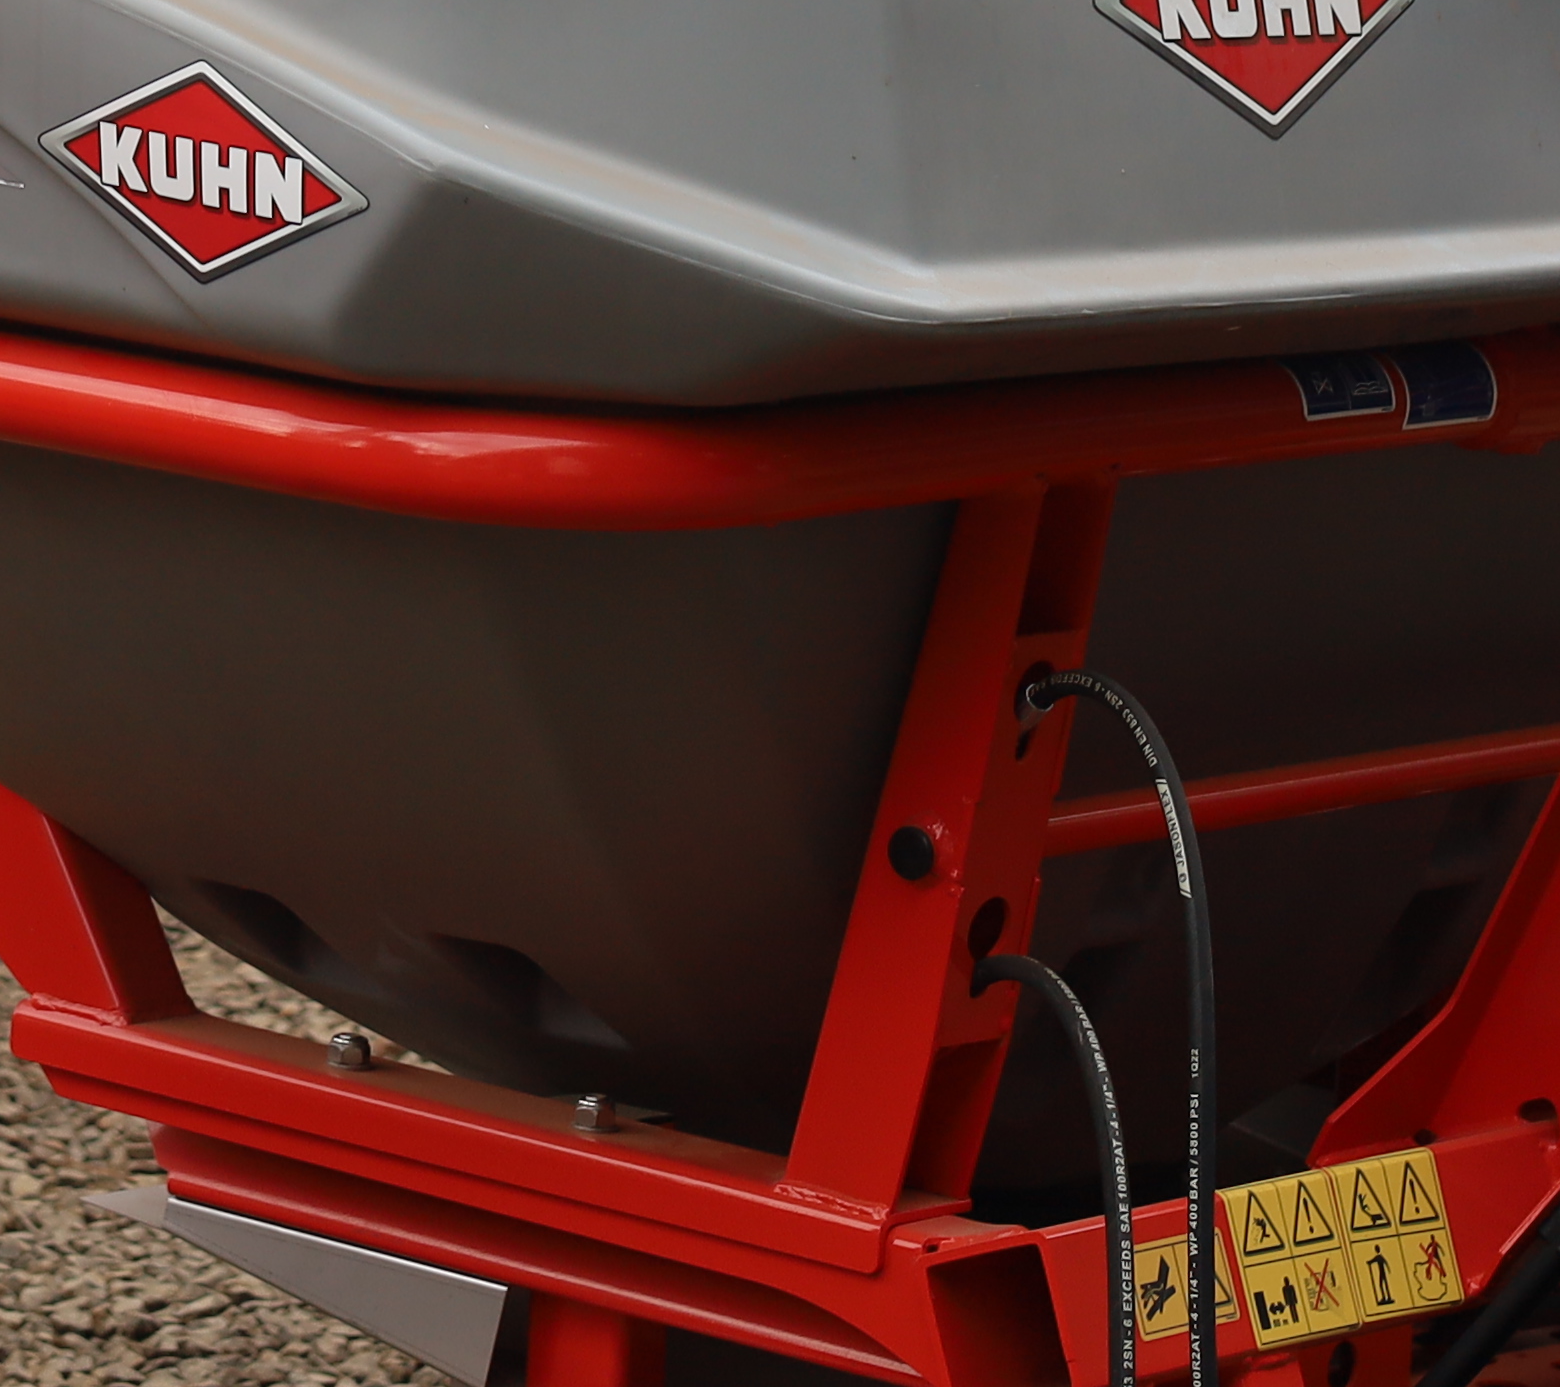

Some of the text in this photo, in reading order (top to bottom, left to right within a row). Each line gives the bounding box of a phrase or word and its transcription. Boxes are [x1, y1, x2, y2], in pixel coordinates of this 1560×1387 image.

[97, 121, 305, 225] KUHN
[1160, 789, 1185, 868] JASONFLEX
[1093, 1051, 1109, 1073] WP
[1190, 1093, 1200, 1118] PSI
[1112, 1138, 1129, 1198] 100R2AT
[1188, 1168, 1199, 1199] BAR
[1120, 1203, 1132, 1234] SAE
[1188, 1200, 1199, 1230] 400
[1189, 1231, 1200, 1257] WP
[1121, 1238, 1133, 1312] EXCEEDS
[1122, 1339, 1134, 1370] 2SN
[1191, 1332, 1202, 1387] 00R2AT
